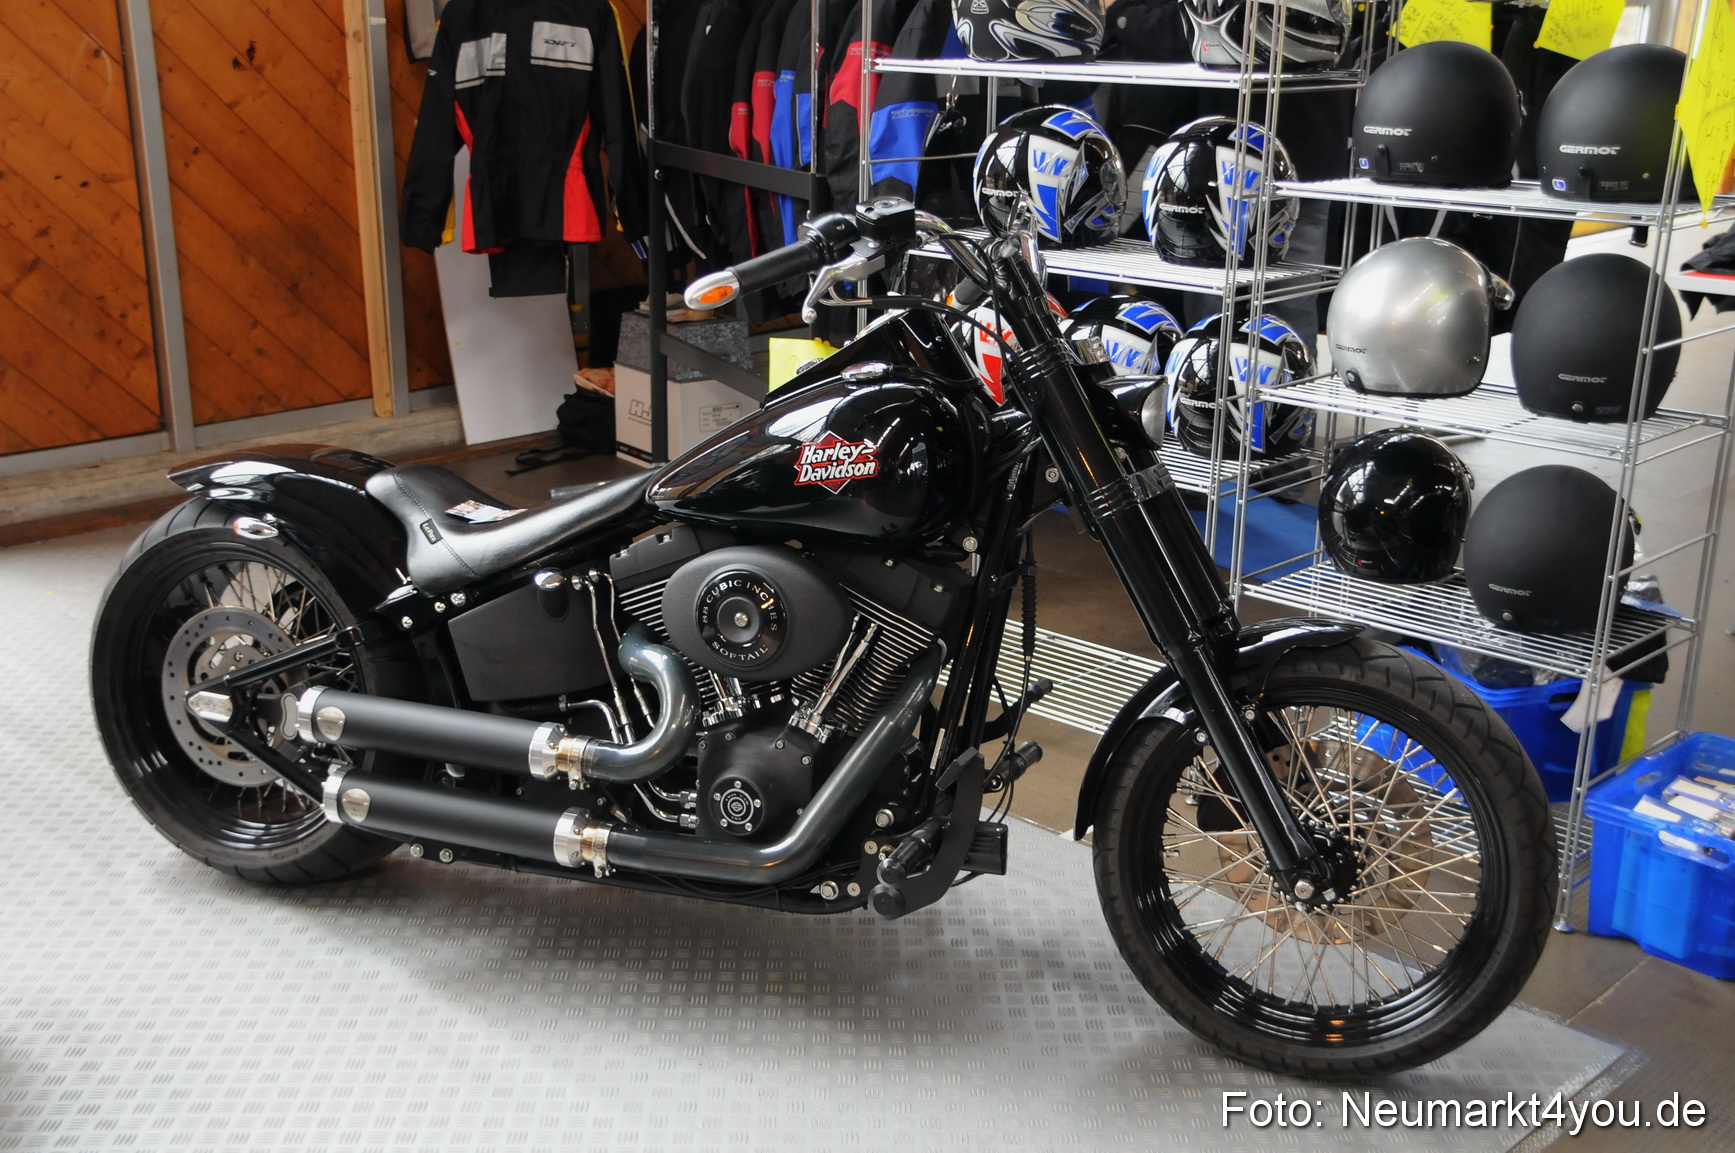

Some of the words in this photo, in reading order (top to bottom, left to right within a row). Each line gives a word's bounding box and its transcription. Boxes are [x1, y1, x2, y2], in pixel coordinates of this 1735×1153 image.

[798, 460, 876, 483] Davidson
[705, 579, 743, 604] CUBIC
[711, 641, 769, 661] SOFTAIL
